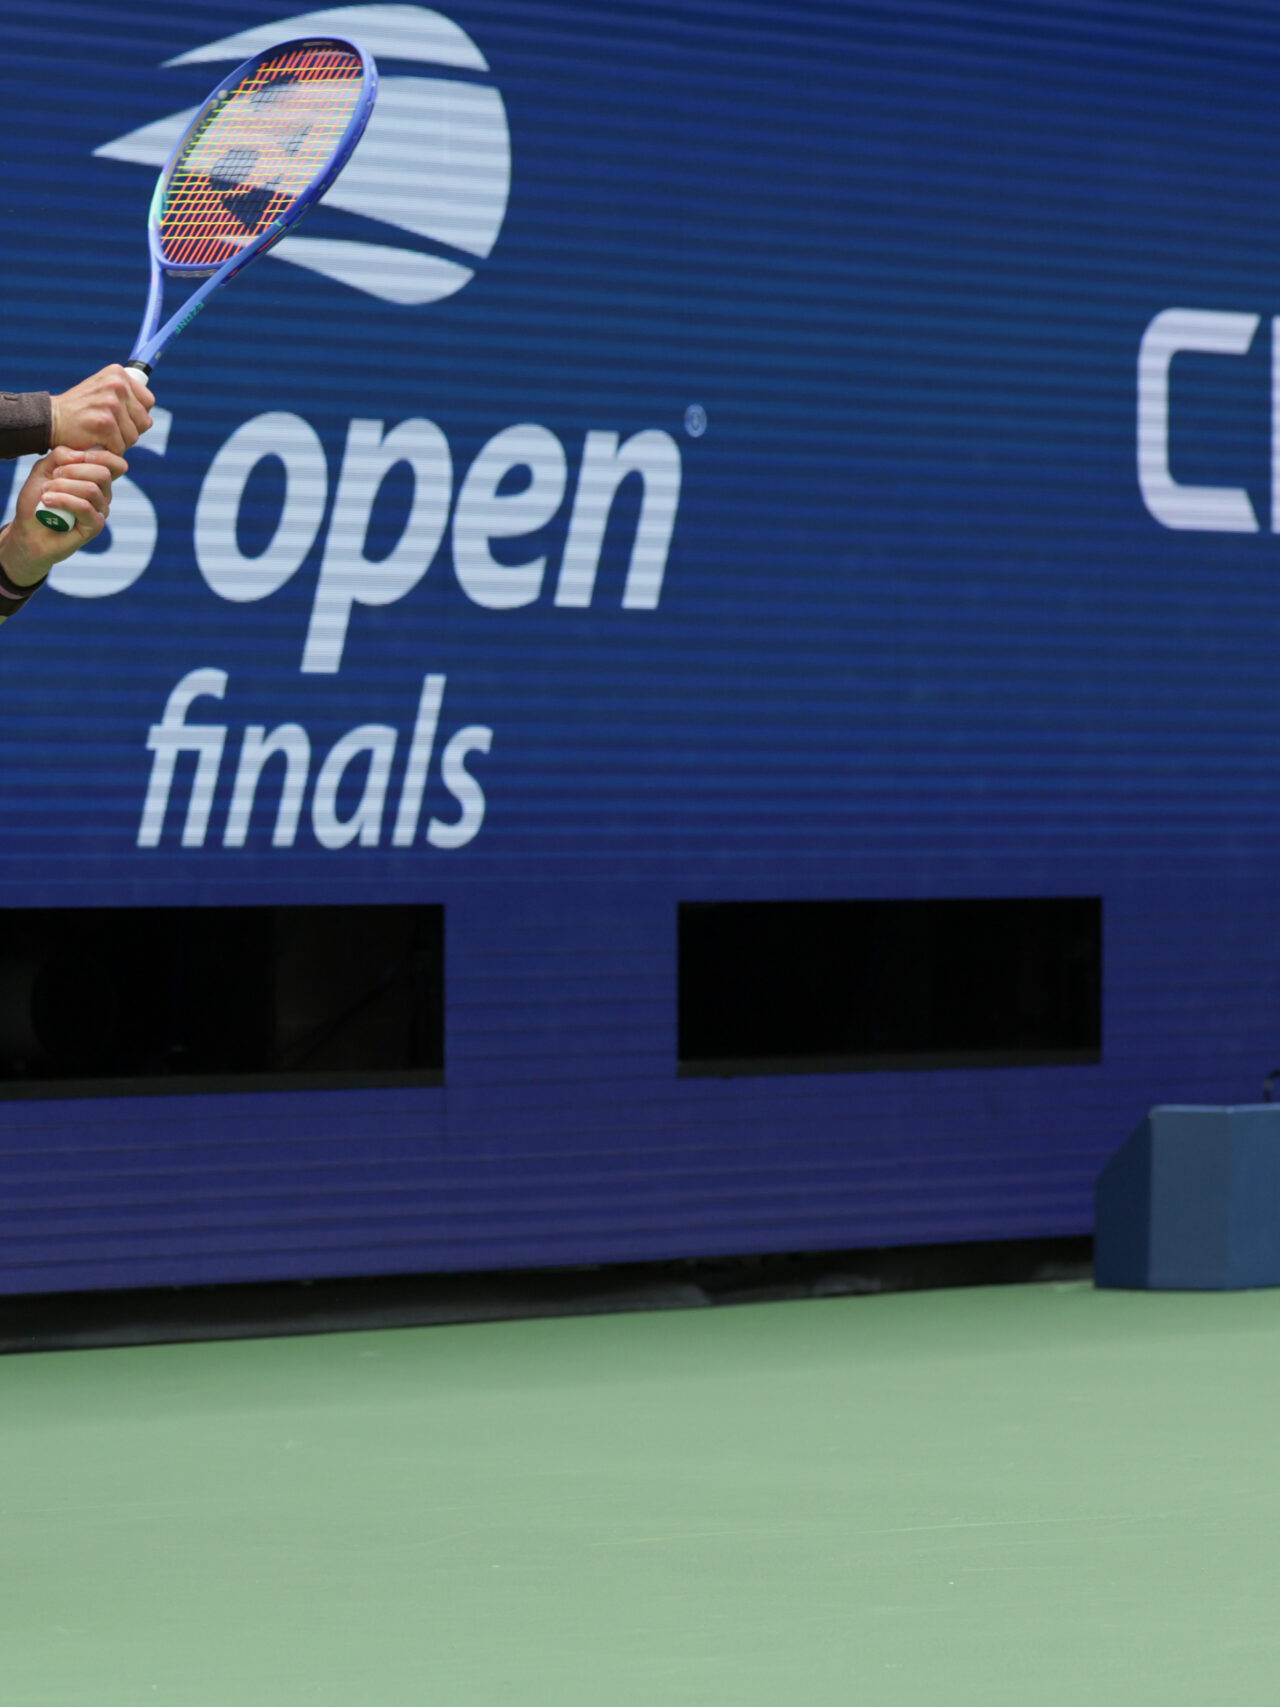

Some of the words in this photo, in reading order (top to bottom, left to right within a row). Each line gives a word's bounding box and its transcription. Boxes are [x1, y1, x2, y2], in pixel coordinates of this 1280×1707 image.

[1136, 306, 1280, 534] C
[194, 411, 682, 674] open
[136, 668, 493, 849] finals
